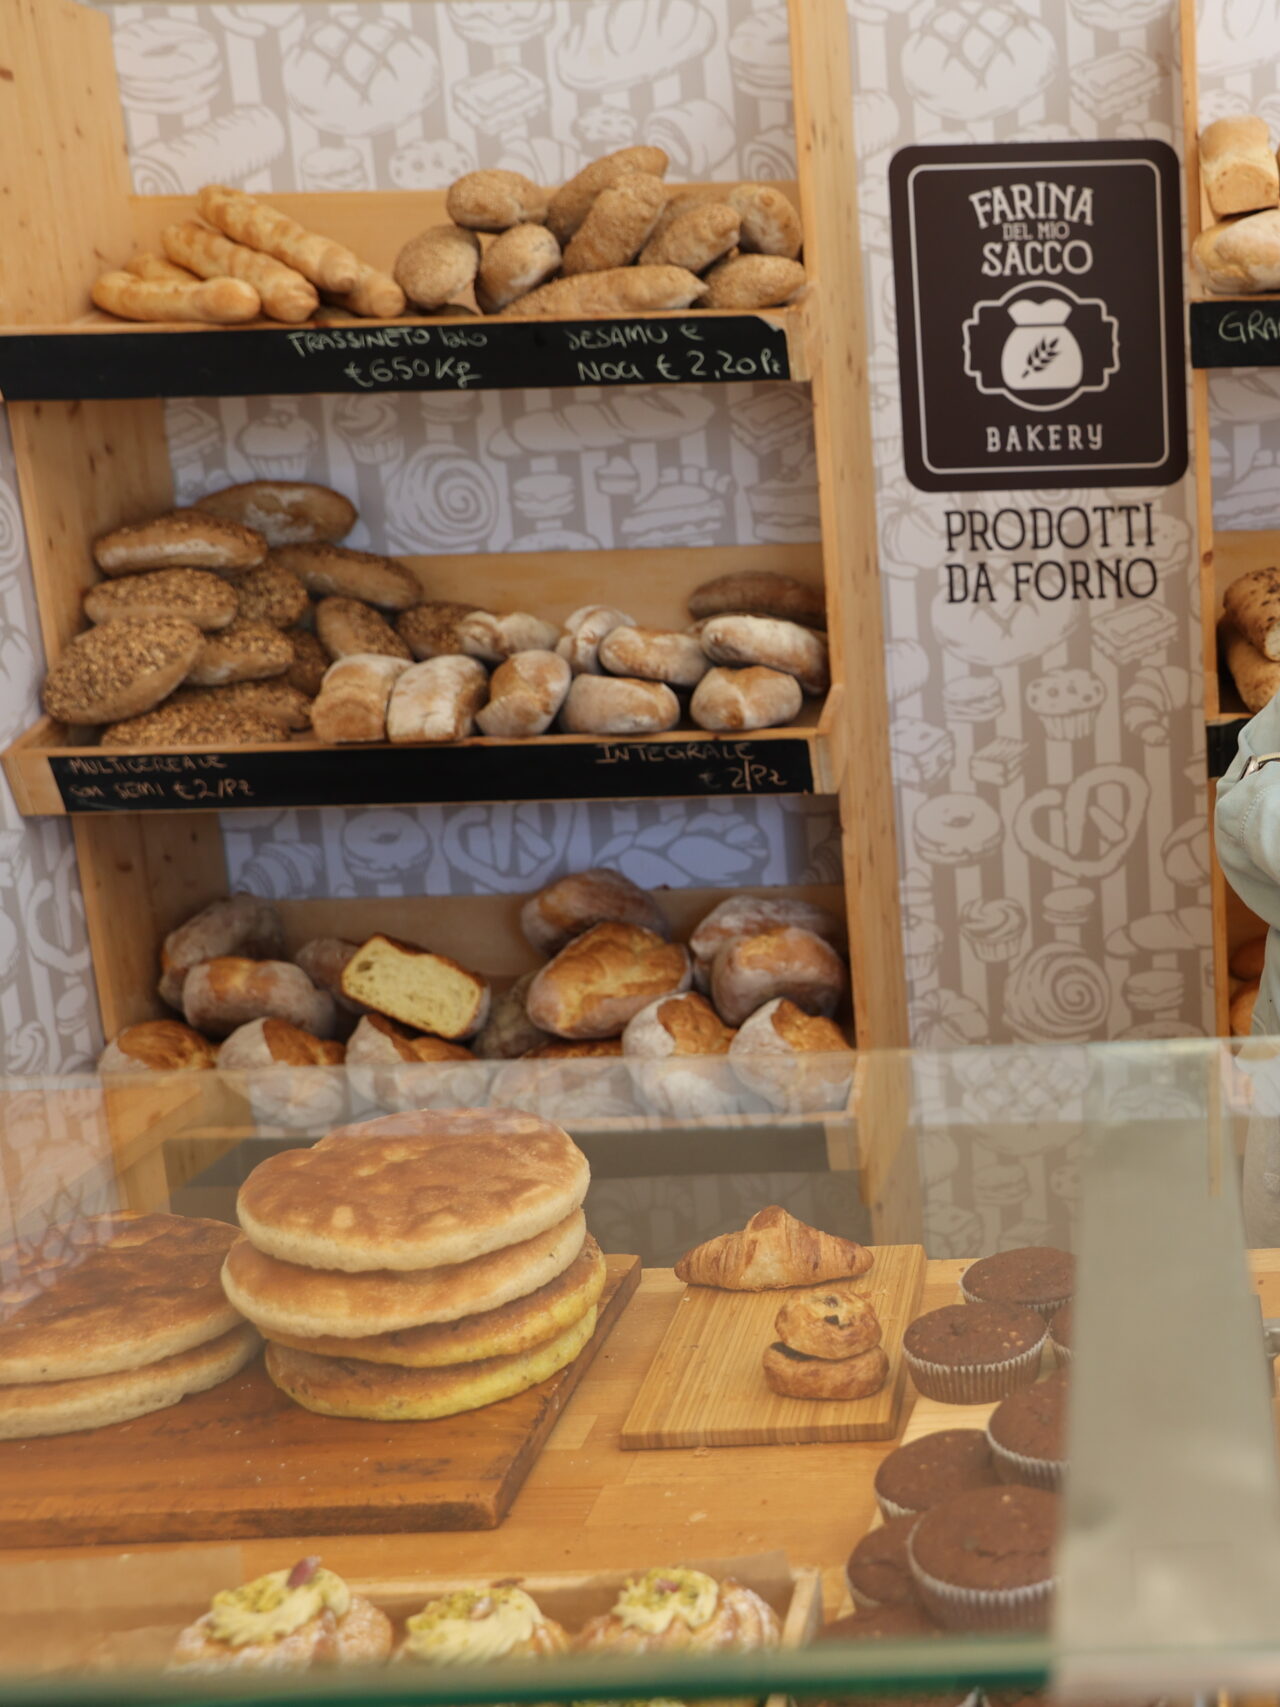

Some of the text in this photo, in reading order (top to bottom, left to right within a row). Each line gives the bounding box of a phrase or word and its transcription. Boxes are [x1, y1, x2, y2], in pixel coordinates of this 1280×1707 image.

[968, 181, 1094, 229] FARINA
[1002, 221, 1070, 240] DEL MIO
[981, 239, 1093, 277] SACCO
[986, 424, 1103, 452] BAKERY
[944, 503, 1155, 552] PRODOTTI
[945, 558, 1157, 603] DA FORNO
[595, 742, 755, 764] INTEGRALE
